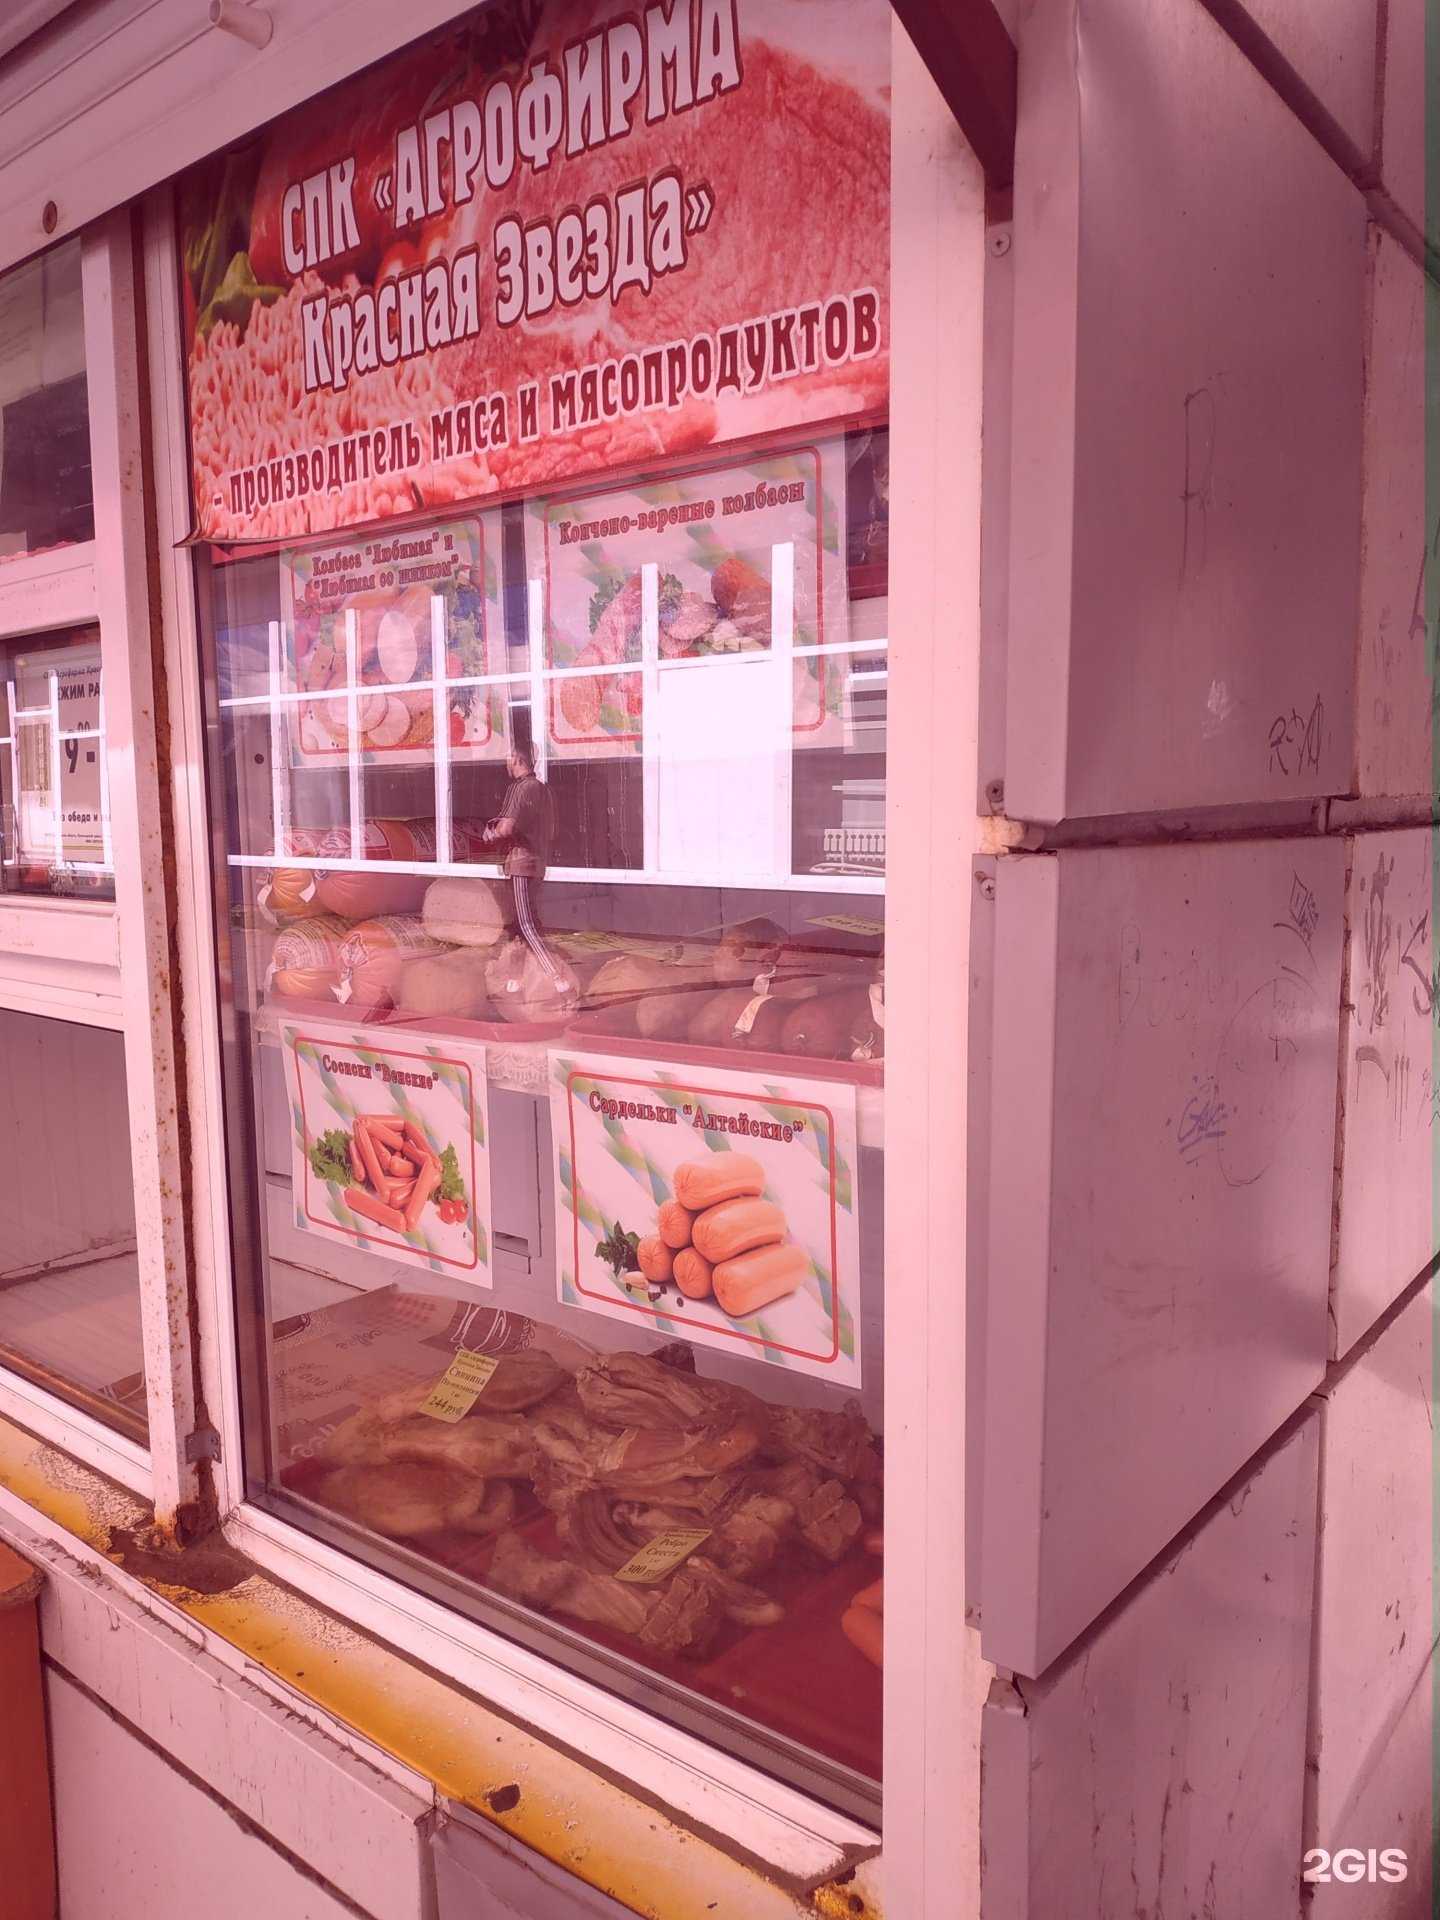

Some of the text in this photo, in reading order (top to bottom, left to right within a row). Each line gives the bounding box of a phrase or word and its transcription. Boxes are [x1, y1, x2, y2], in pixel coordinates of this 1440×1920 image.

[281, 0, 742, 275] СПК «АГРОФИРМА
[301, 169, 713, 392] Красная Звезда»
[229, 428, 421, 516] производитель
[431, 394, 505, 459] мяса
[518, 384, 538, 437] и
[551, 292, 880, 432] мясопродуктов
[559, 482, 805, 545] Копчено-вареные колбасы
[443, 534, 453, 550] и
[380, 571, 394, 588] со
[67, 811, 91, 824] обеда
[322, 1054, 372, 1080] Сосиски
[589, 1090, 677, 1125] Сардельки
